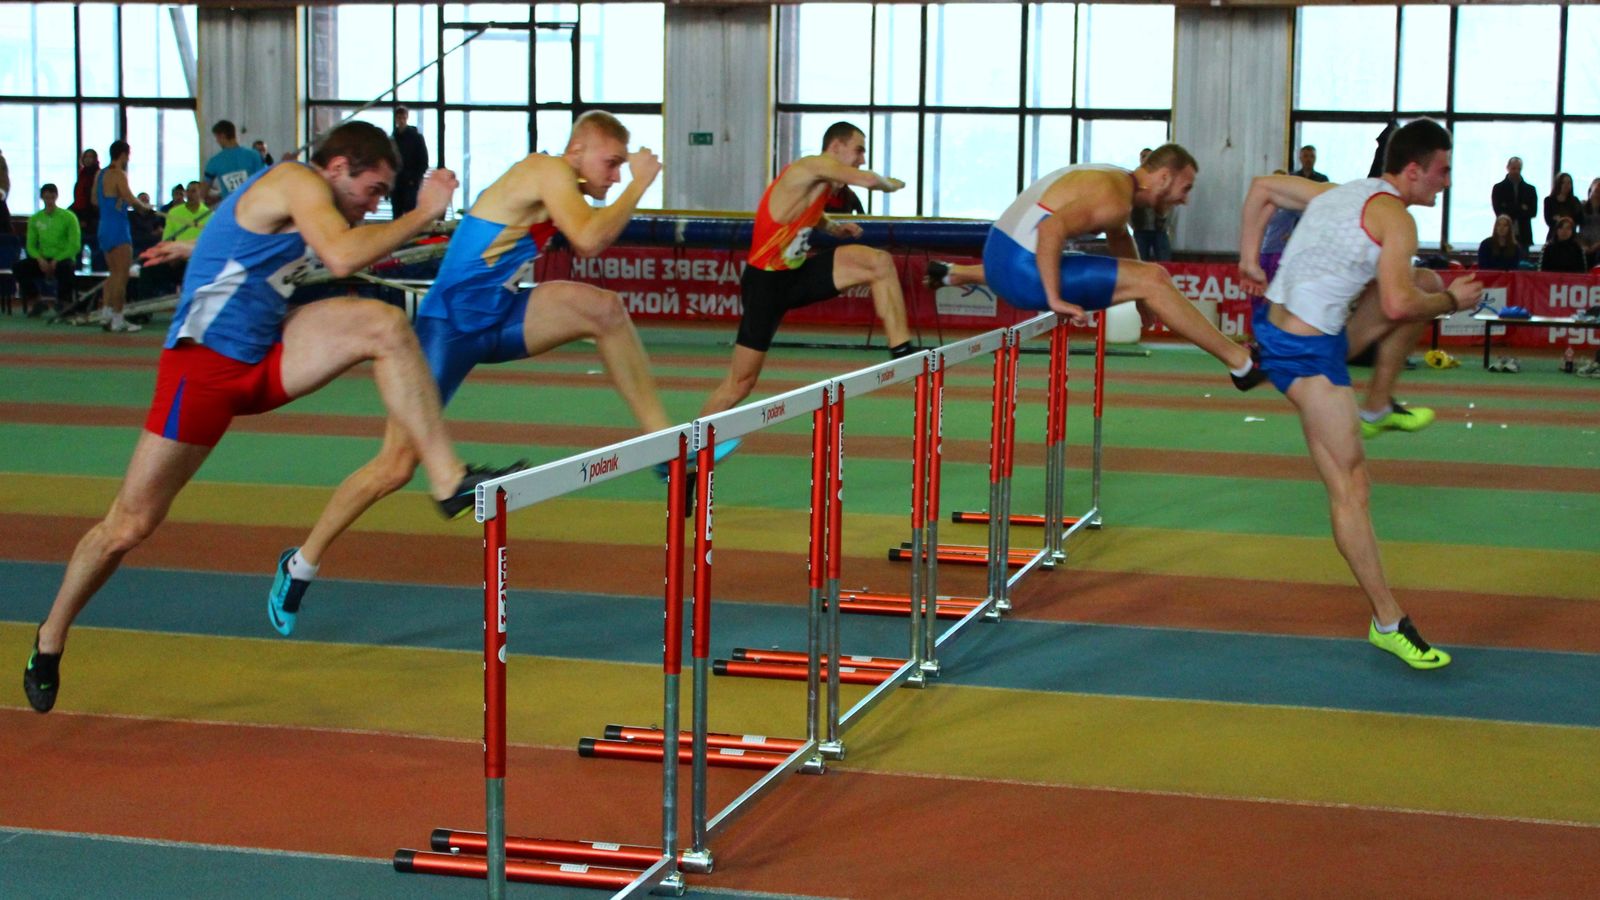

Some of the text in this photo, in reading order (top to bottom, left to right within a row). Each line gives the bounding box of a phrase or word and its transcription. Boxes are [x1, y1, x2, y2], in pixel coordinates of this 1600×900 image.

[571, 257, 656, 279] НОВЫЕ
[617, 288, 680, 314] СКОЙ
[1171, 275, 1247, 302] ЕЗДЫ
[589, 453, 618, 482] polanik
